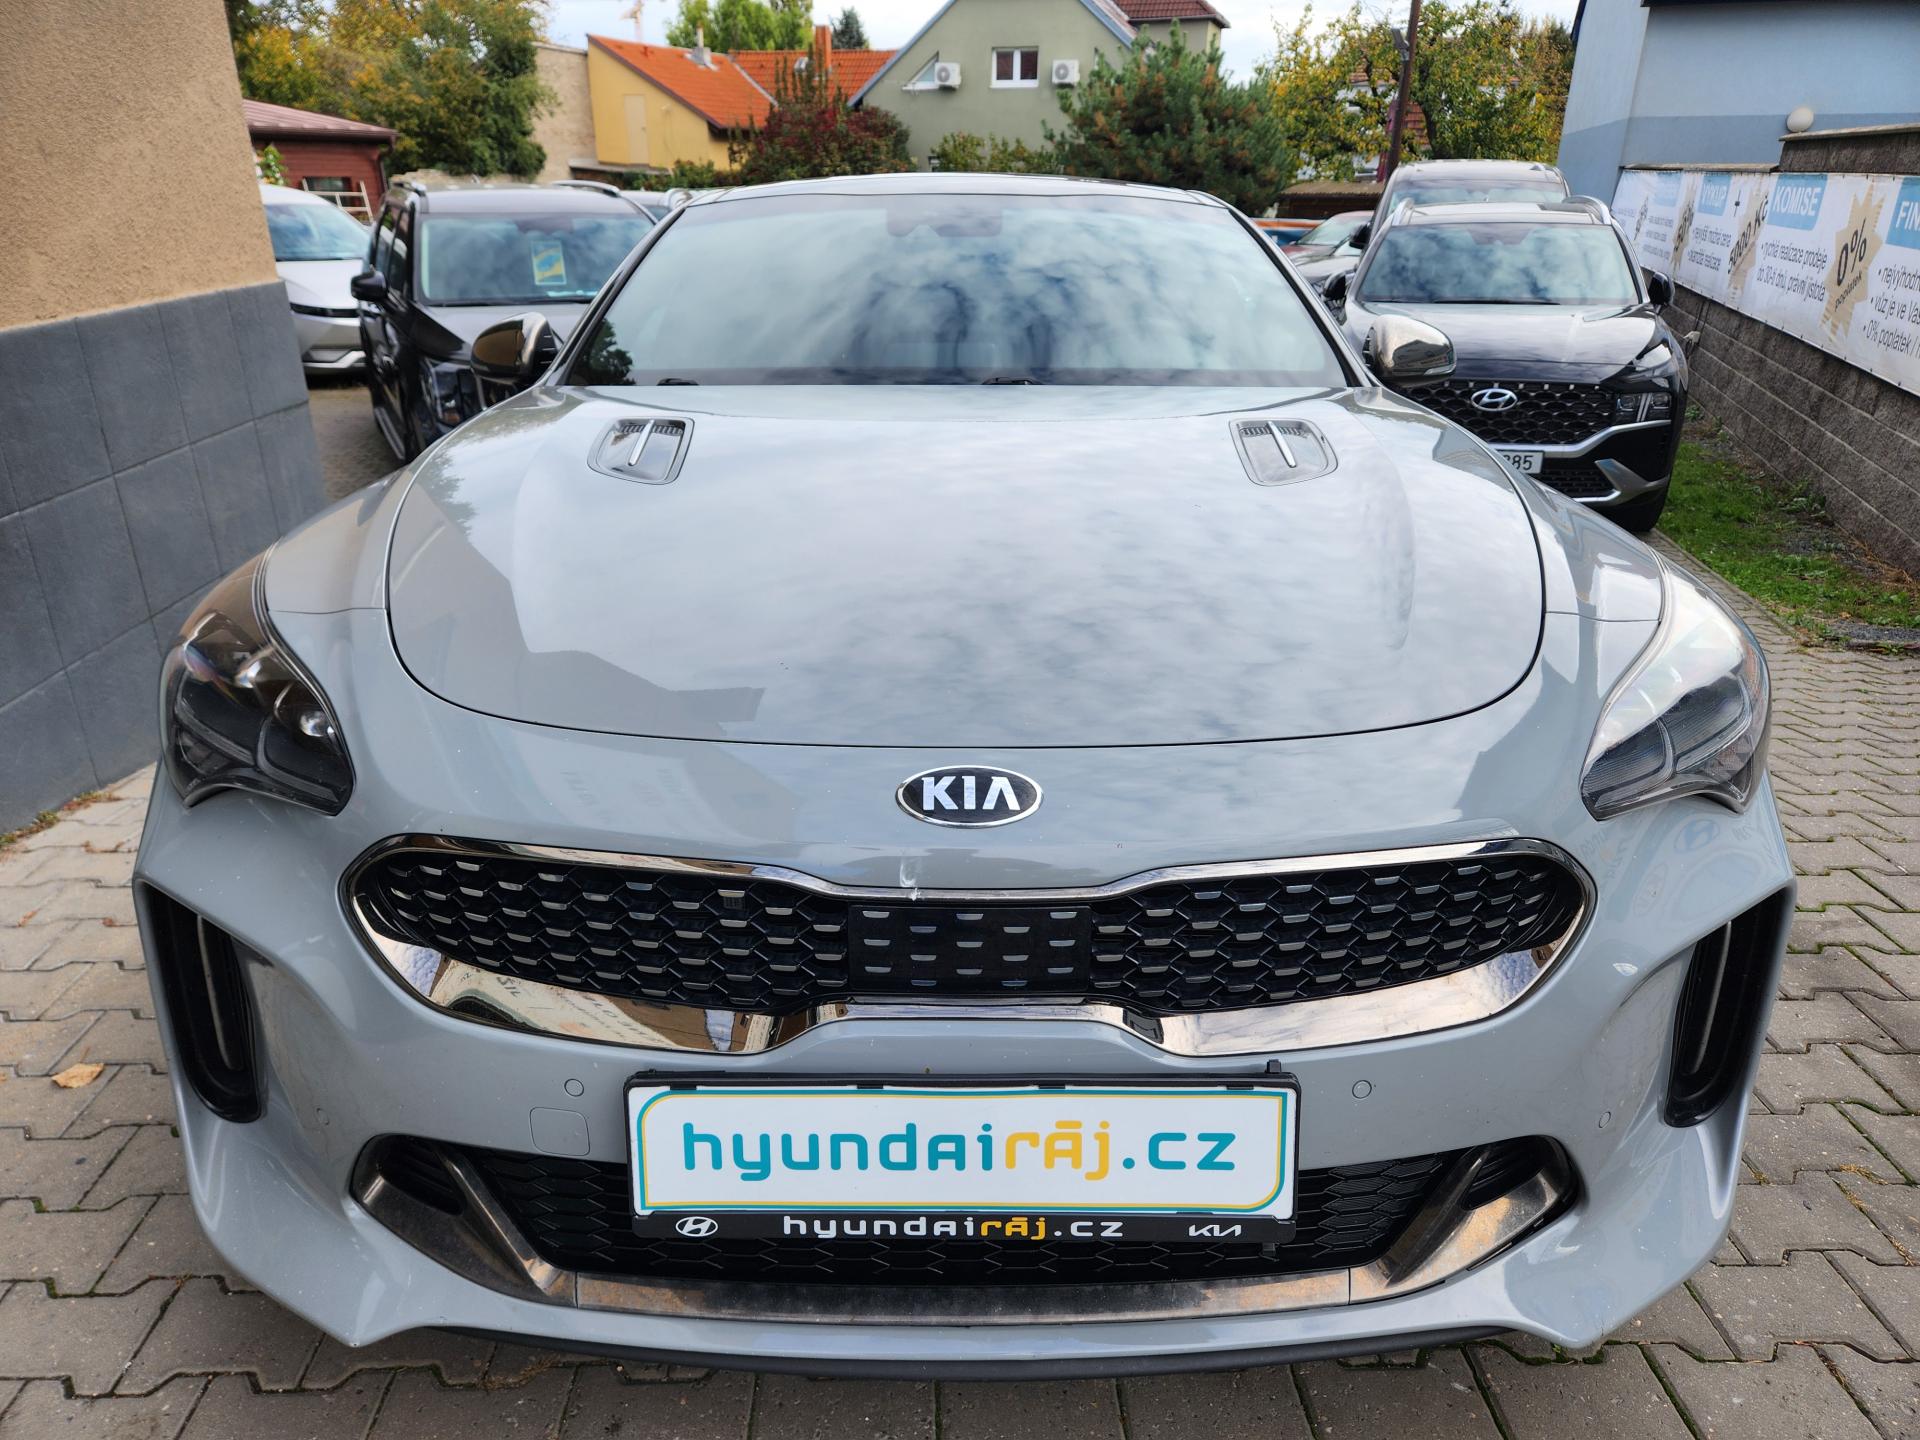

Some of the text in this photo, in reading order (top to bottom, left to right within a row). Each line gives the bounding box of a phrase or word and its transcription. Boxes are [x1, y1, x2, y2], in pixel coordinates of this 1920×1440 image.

[1773, 185, 1822, 217] KOMISE
[1837, 217, 1867, 287] 0%
[1877, 328, 1912, 356] poplatek
[921, 775, 1021, 811] KIA
